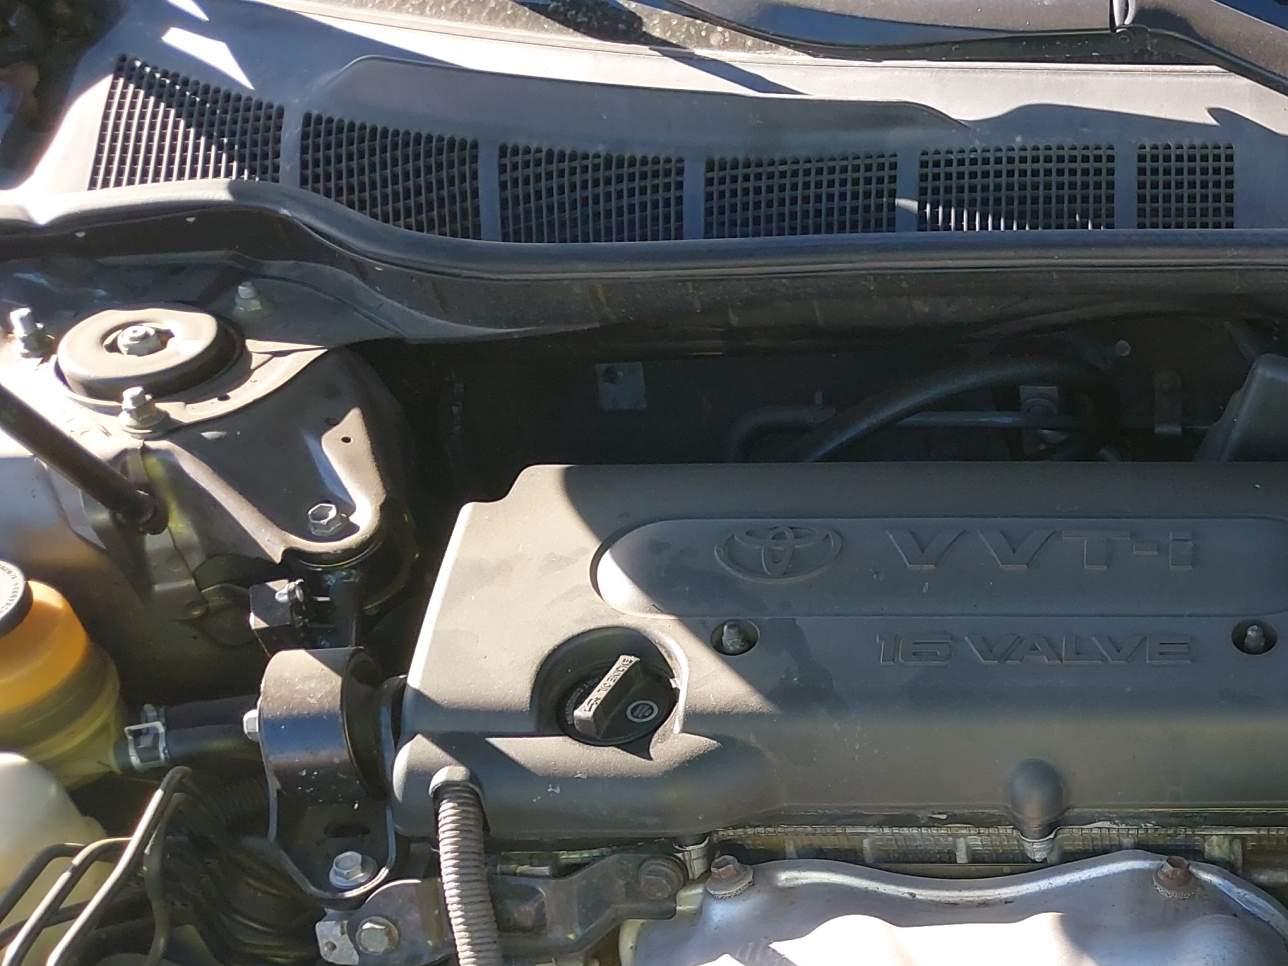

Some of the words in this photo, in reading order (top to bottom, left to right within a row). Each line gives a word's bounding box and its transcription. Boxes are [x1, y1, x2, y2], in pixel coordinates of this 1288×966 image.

[886, 529, 1193, 570] VVT-i
[877, 633, 952, 664] 16
[965, 634, 1196, 664] VALVE
